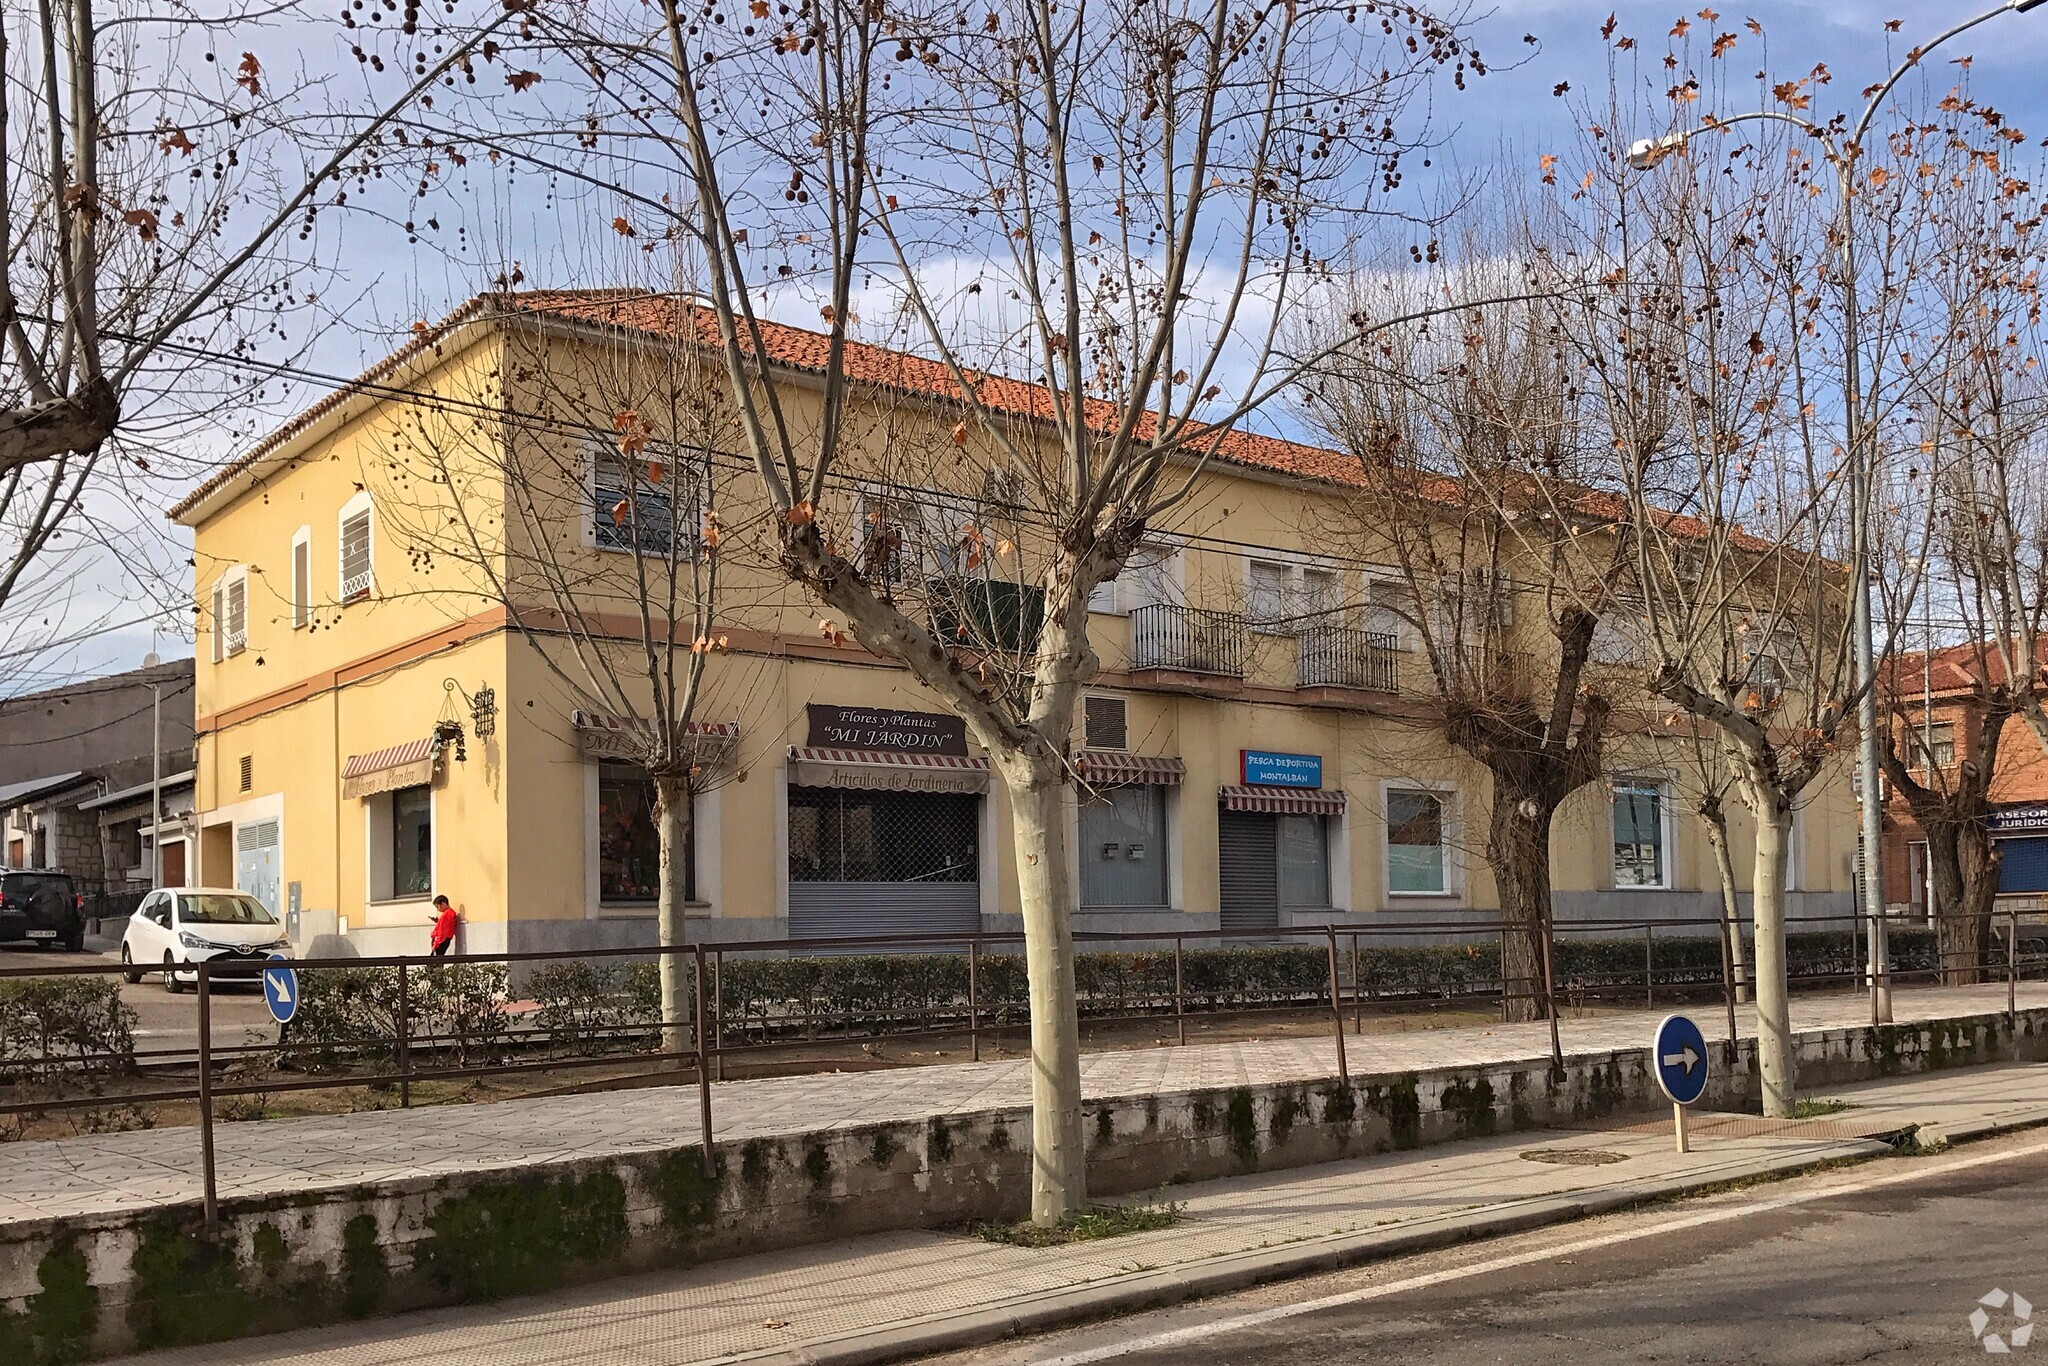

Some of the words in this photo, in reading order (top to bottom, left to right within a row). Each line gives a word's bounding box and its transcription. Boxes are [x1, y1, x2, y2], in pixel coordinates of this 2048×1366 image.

[838, 710, 878, 724] Flores
[879, 716, 890, 727] y
[890, 714, 937, 728] Plantas
[1247, 755, 1275, 766] PESCA
[1275, 758, 1319, 769] DEPORTIVA
[887, 773, 901, 788] de
